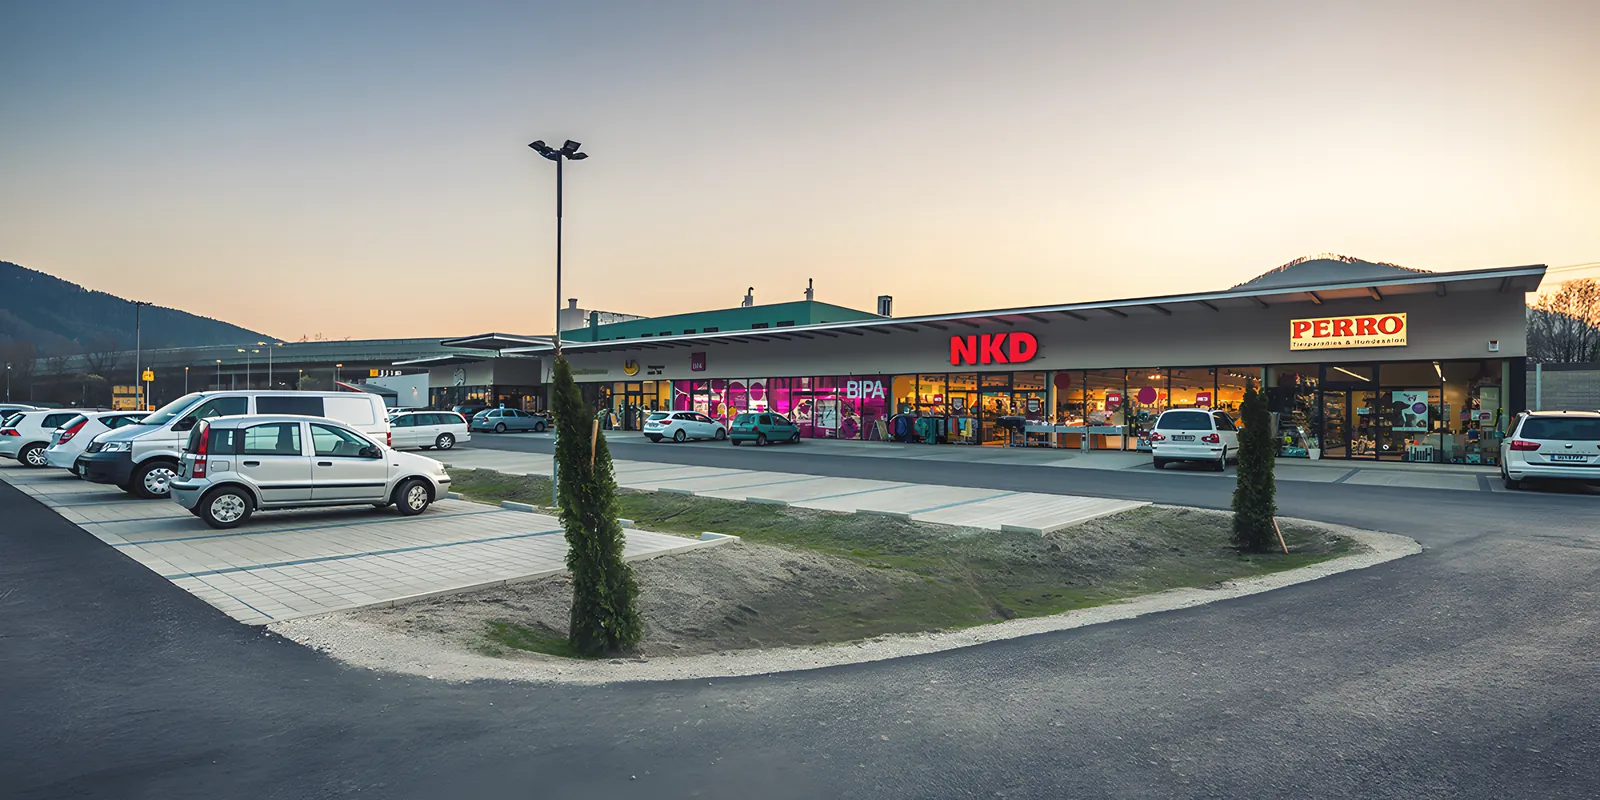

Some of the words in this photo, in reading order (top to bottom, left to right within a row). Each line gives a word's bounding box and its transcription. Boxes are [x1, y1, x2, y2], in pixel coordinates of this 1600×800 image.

[1292, 316, 1404, 339] PERRO
[950, 331, 1038, 365] NKD
[847, 380, 885, 399] BIPA
